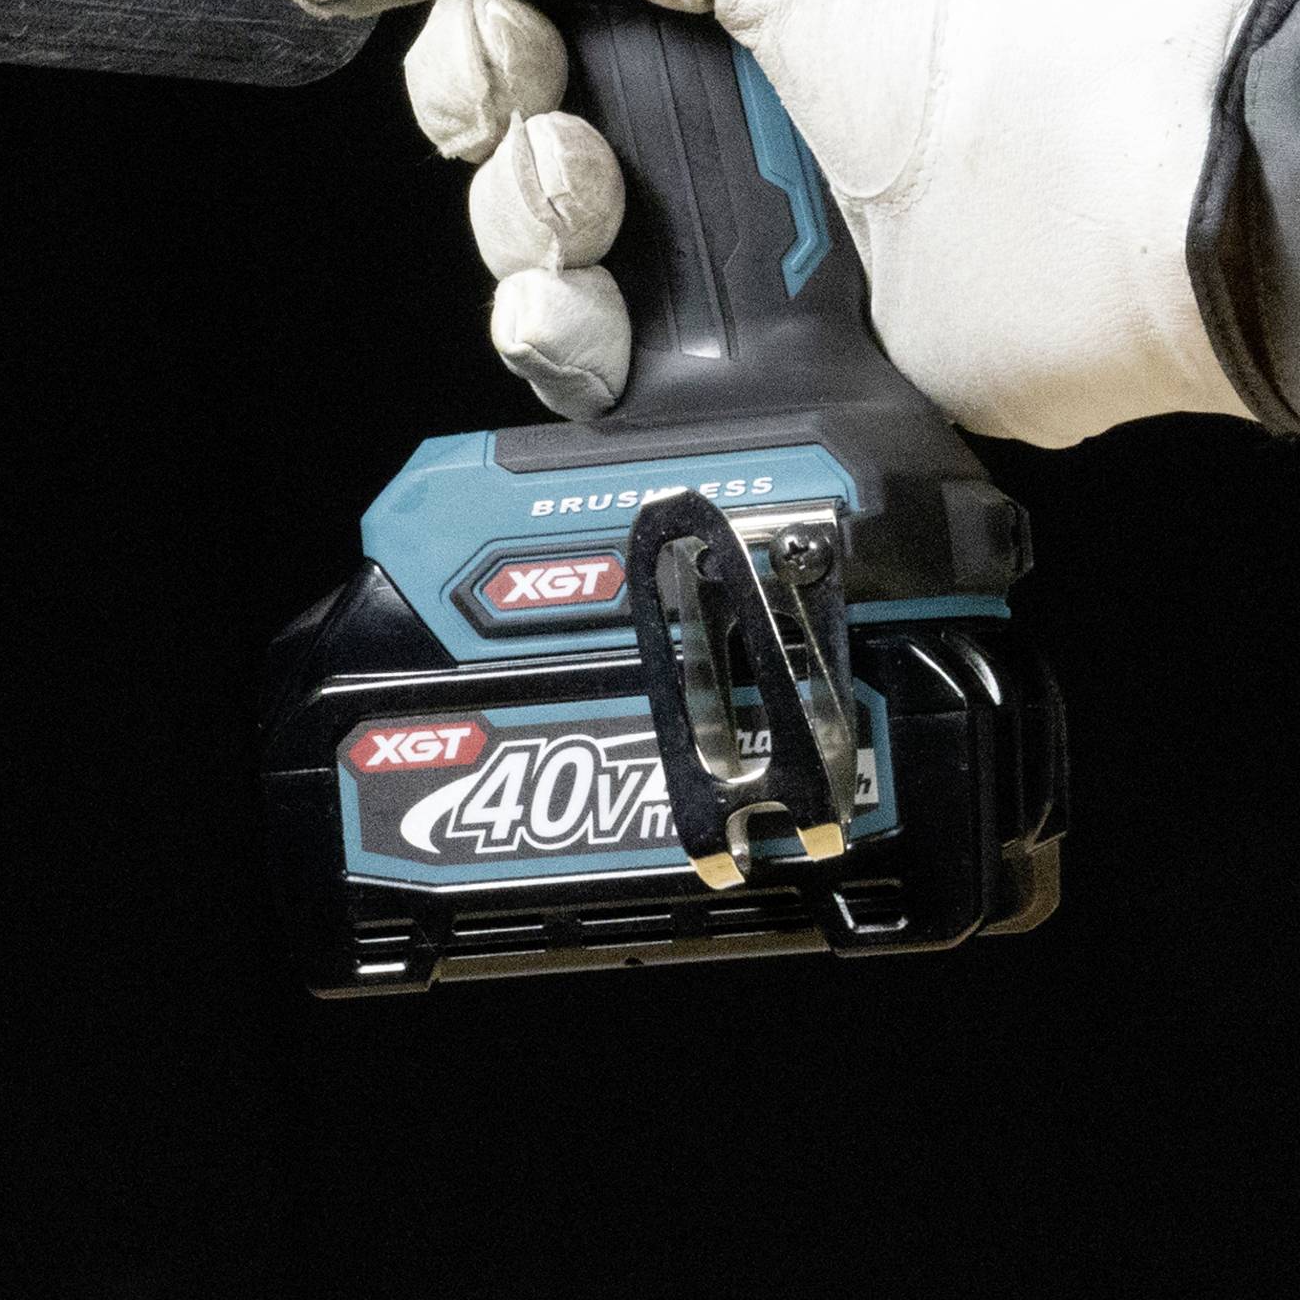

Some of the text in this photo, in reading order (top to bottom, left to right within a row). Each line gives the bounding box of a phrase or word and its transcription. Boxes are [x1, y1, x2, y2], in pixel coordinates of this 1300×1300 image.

[531, 476, 773, 517] BRUSESS
[503, 562, 609, 604] XGT
[366, 727, 471, 767] XGT
